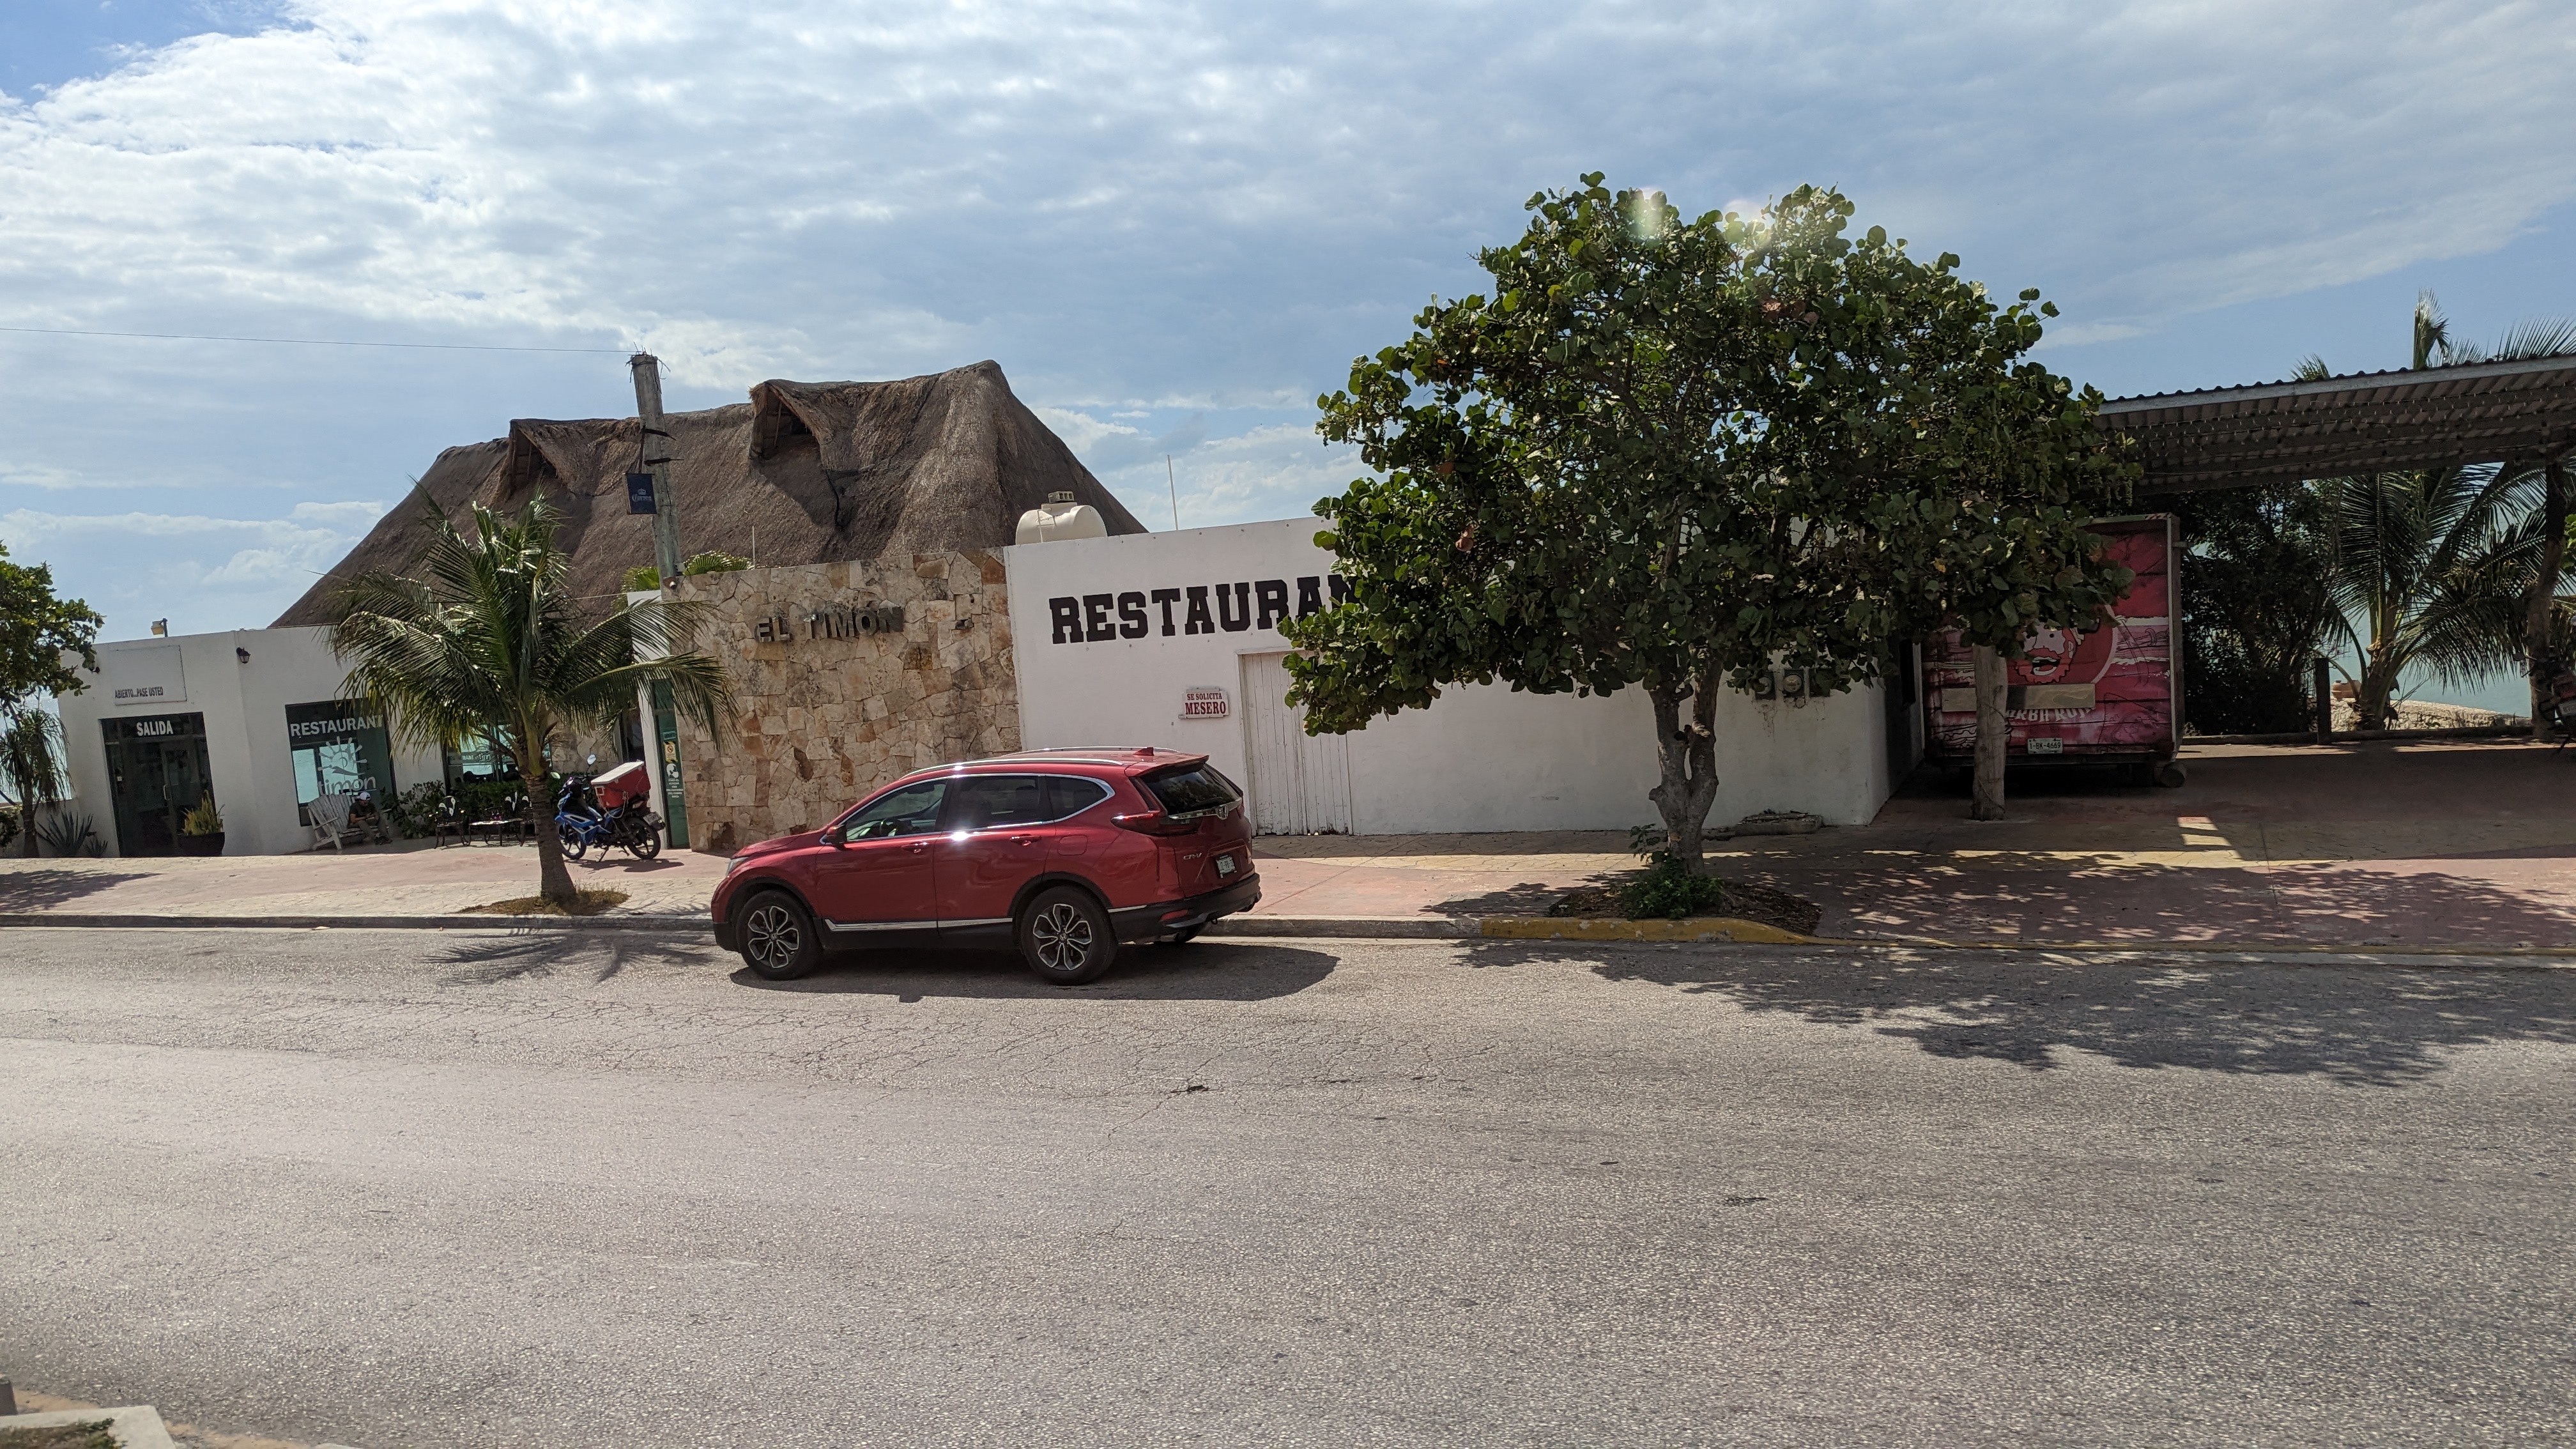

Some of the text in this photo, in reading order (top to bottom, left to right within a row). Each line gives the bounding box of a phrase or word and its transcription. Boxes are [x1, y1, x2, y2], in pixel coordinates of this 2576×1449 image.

[755, 617, 790, 643] EL
[1196, 692, 1223, 701] SOLICITA
[1185, 701, 1226, 715] MESERO
[136, 720, 174, 737] SALIDA
